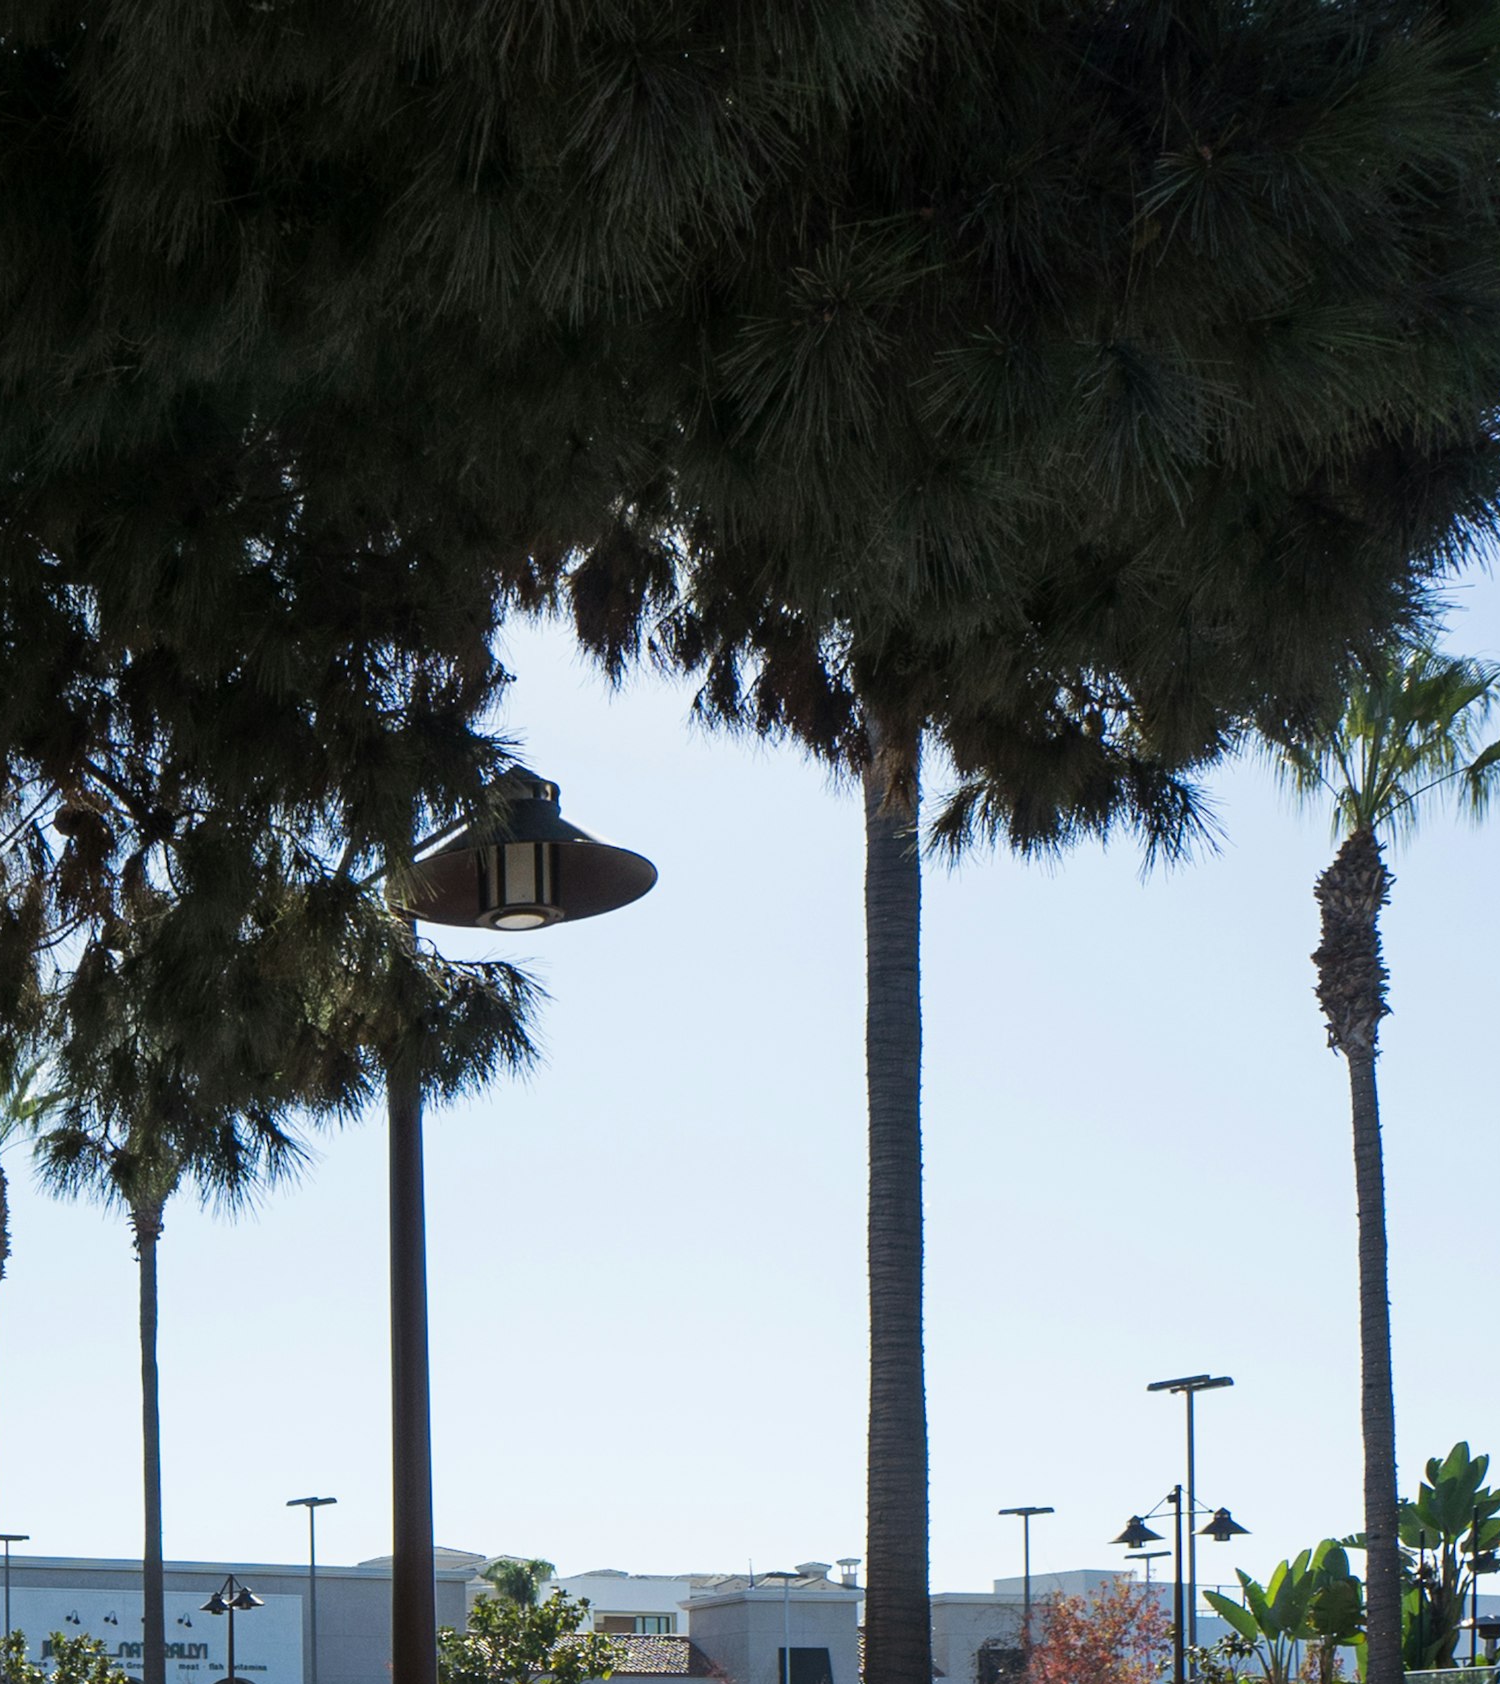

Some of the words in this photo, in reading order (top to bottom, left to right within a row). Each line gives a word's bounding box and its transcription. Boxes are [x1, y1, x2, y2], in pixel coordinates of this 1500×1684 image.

[178, 1663, 200, 1671] meat
[209, 1662, 224, 1671] fish
[231, 1663, 267, 1671] itamins
